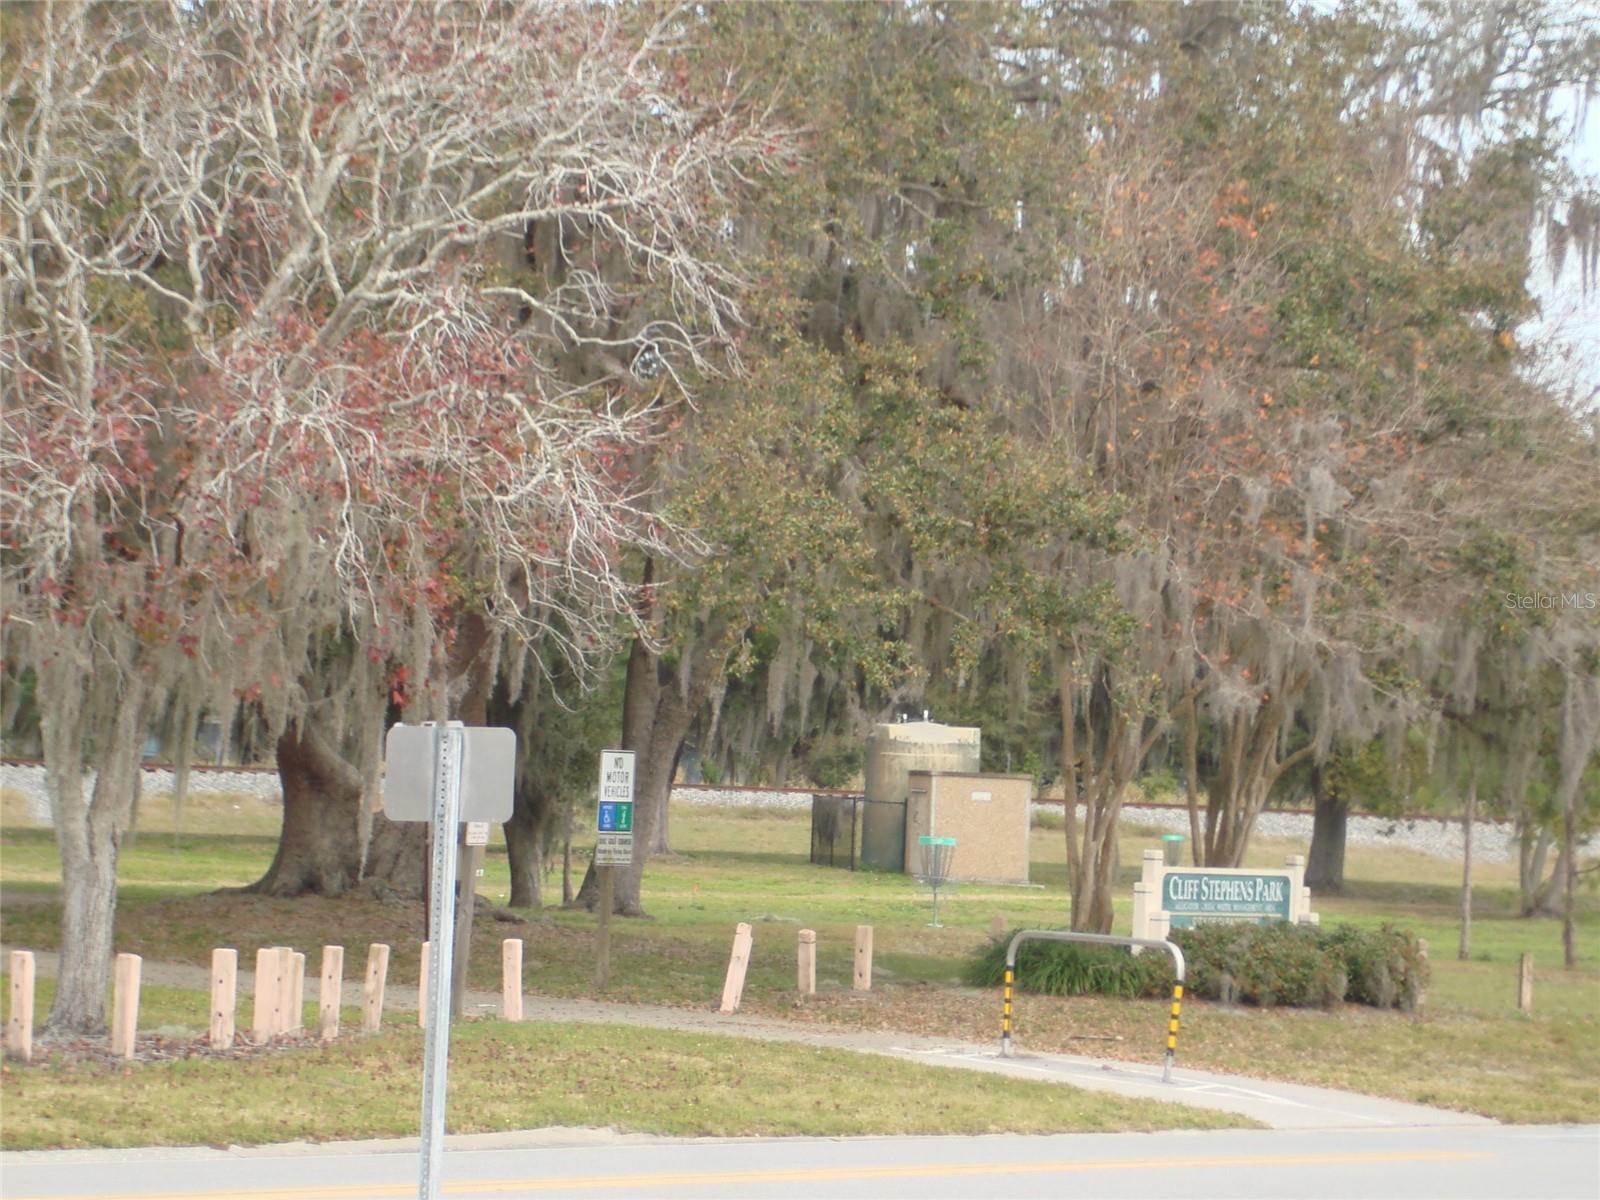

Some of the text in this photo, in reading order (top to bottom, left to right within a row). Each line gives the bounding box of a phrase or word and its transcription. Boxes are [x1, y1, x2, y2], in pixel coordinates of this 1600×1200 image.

[614, 757, 623, 769] NO
[607, 771, 629, 783] MOTOR
[604, 785, 629, 797] VEHICLES
[1169, 875, 1283, 901] CLIFF STEPHENS PARK
